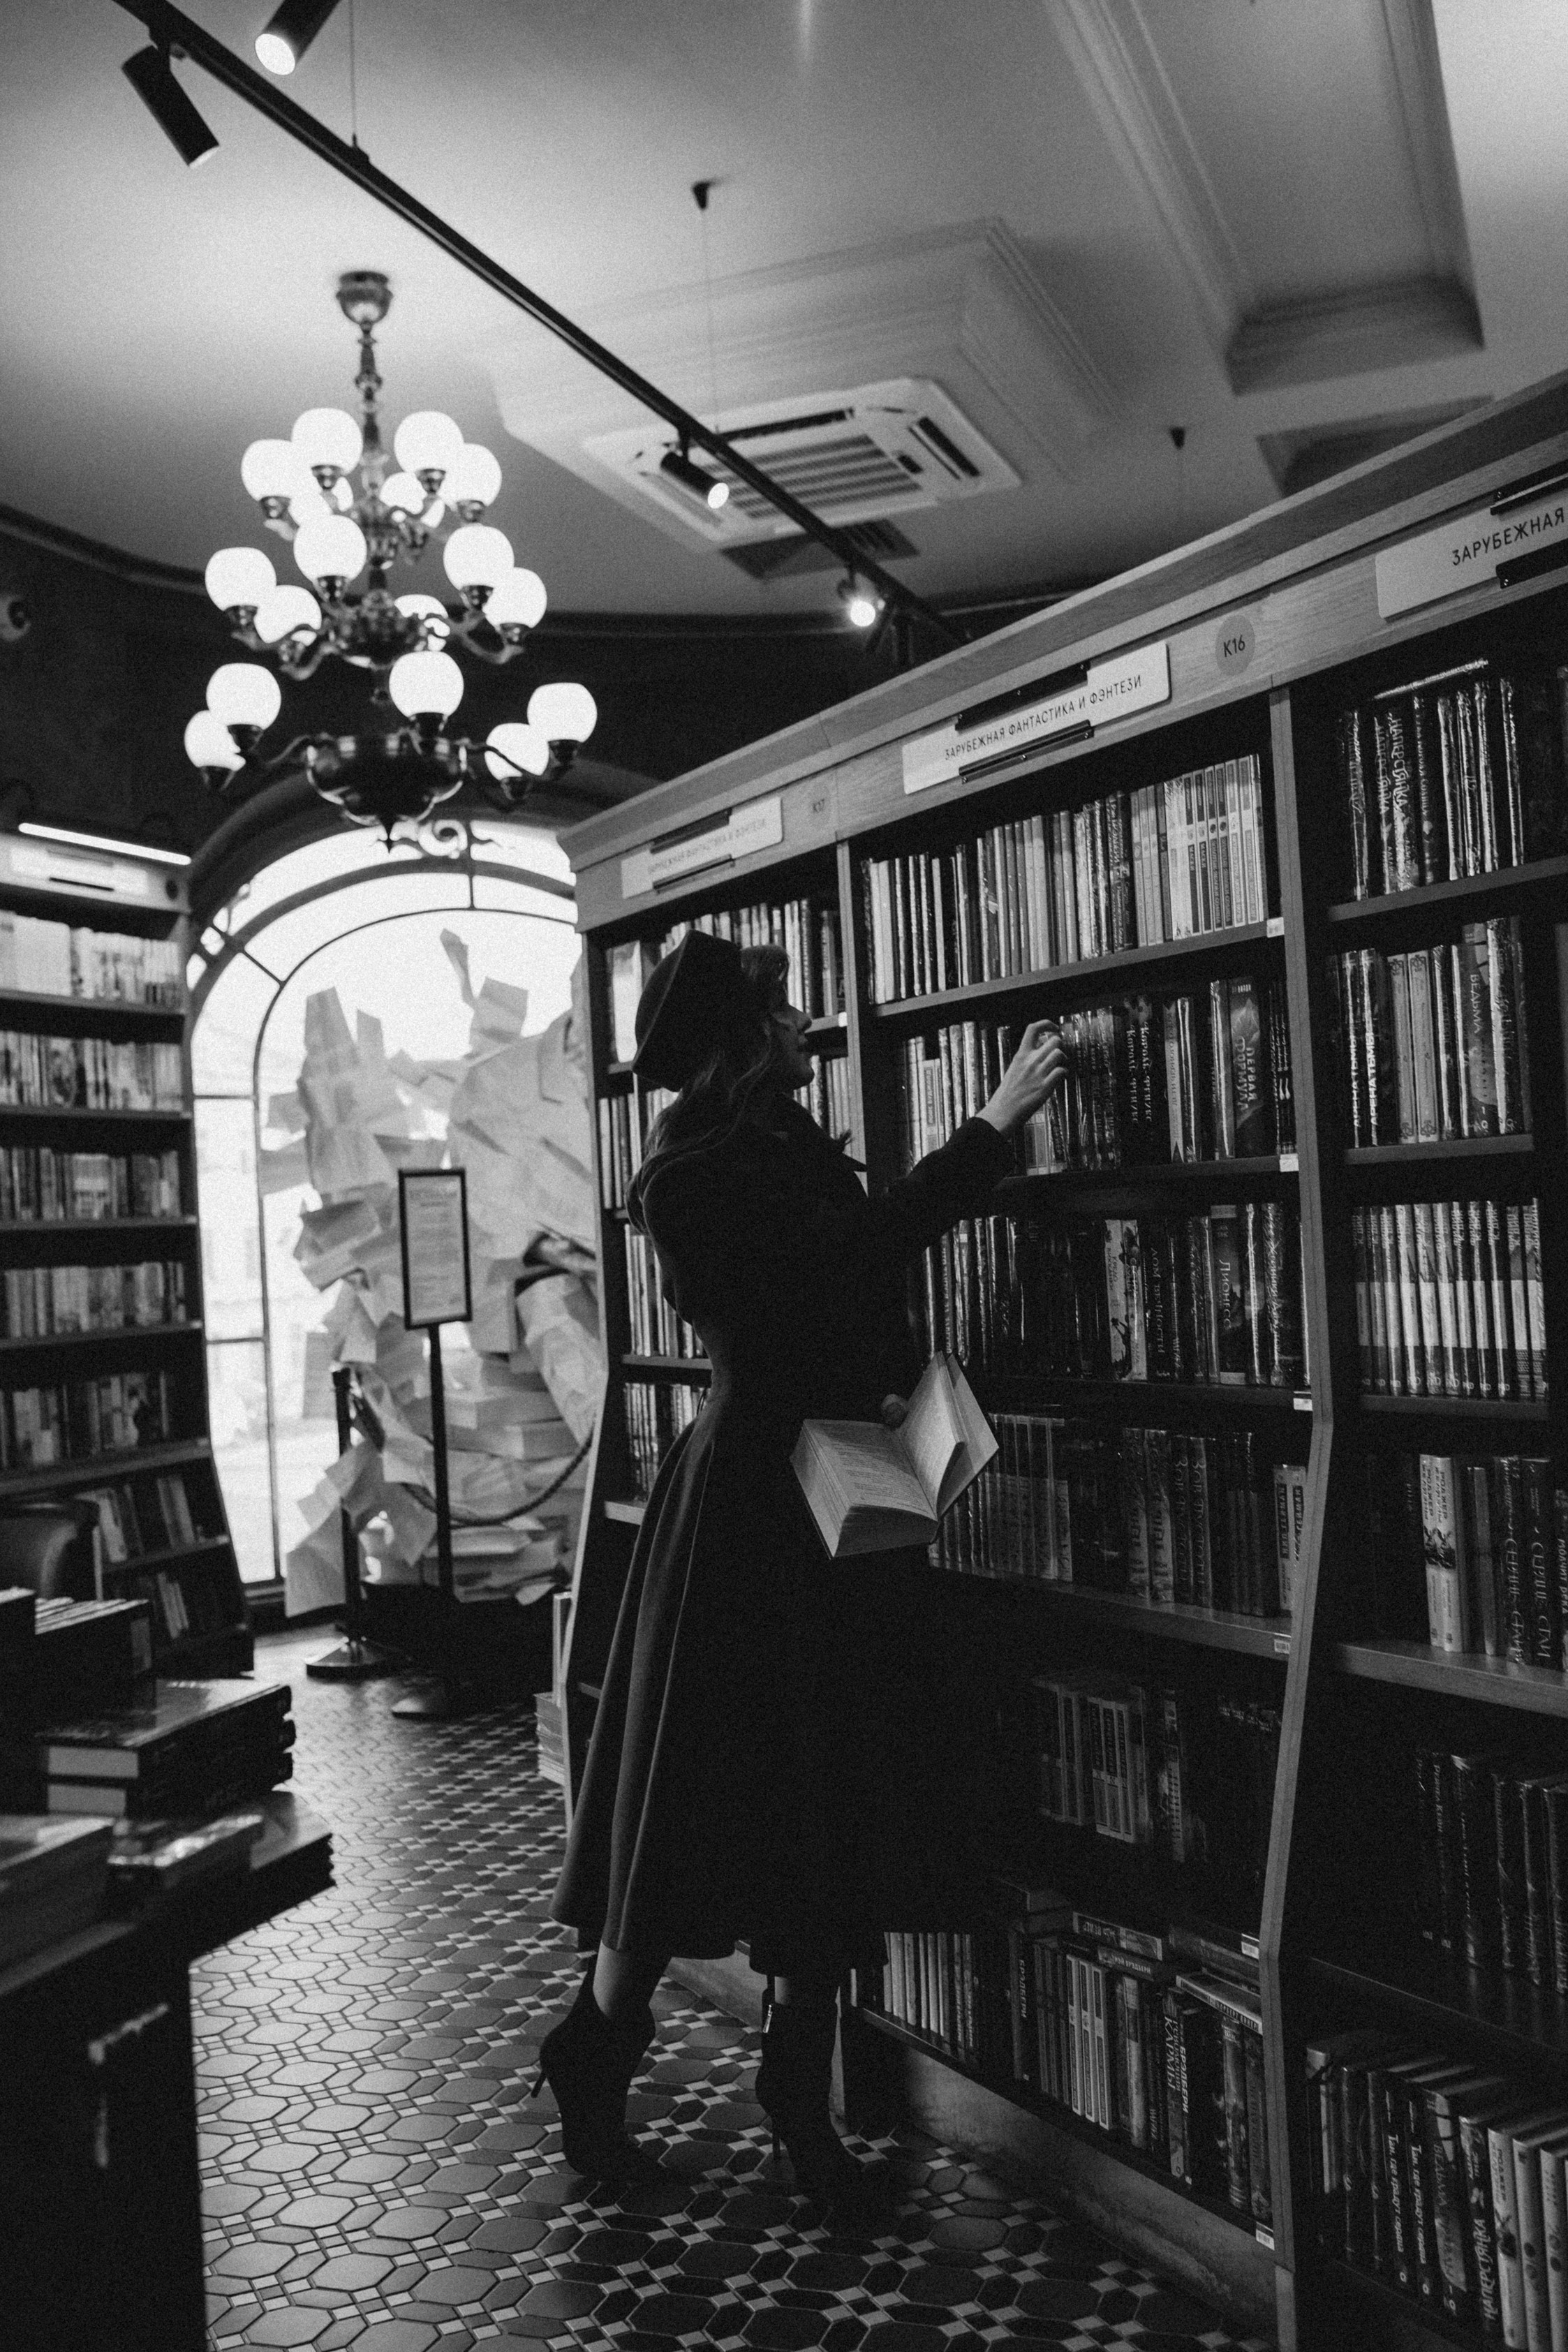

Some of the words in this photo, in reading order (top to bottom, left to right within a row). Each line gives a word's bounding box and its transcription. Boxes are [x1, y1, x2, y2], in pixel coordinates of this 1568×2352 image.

[1452, 507, 1565, 566] ЗАРУБЕЖНАЯ
[945, 727, 1005, 761] ЗАРУБЕЖНАЯ
[1008, 700, 1075, 736] ФАНТАСТИКА
[1079, 695, 1086, 710] И
[1089, 674, 1141, 705] ФЭНТЕЗИ
[1390, 718, 1410, 807] НАПЕРСТЯНКА
[1470, 973, 1483, 1034] ВЕДЬМА
[1235, 1036, 1250, 1113] ФОРМУЛА
[1245, 1046, 1259, 1102] ПЕРВАЯ
[1151, 1248, 1162, 1278] ДОМ
[1218, 1259, 1232, 1330] ЛИОНЕСС
[1174, 1454, 1188, 1491] ЗОВ
[1192, 1458, 1206, 1493] ЗОВ
[1557, 1538, 1568, 1581] МОЛЧИТ
[1018, 1959, 1027, 2018] БРЭДБЕРИ
[1164, 2016, 1176, 2090] КАРМЫ
[1179, 2045, 1190, 2114] БРЭДБЕРИ
[1433, 2143, 1448, 2207] ВЕДЬМА
[1473, 2218, 1499, 2321] НАПЕРСТЯНКА
